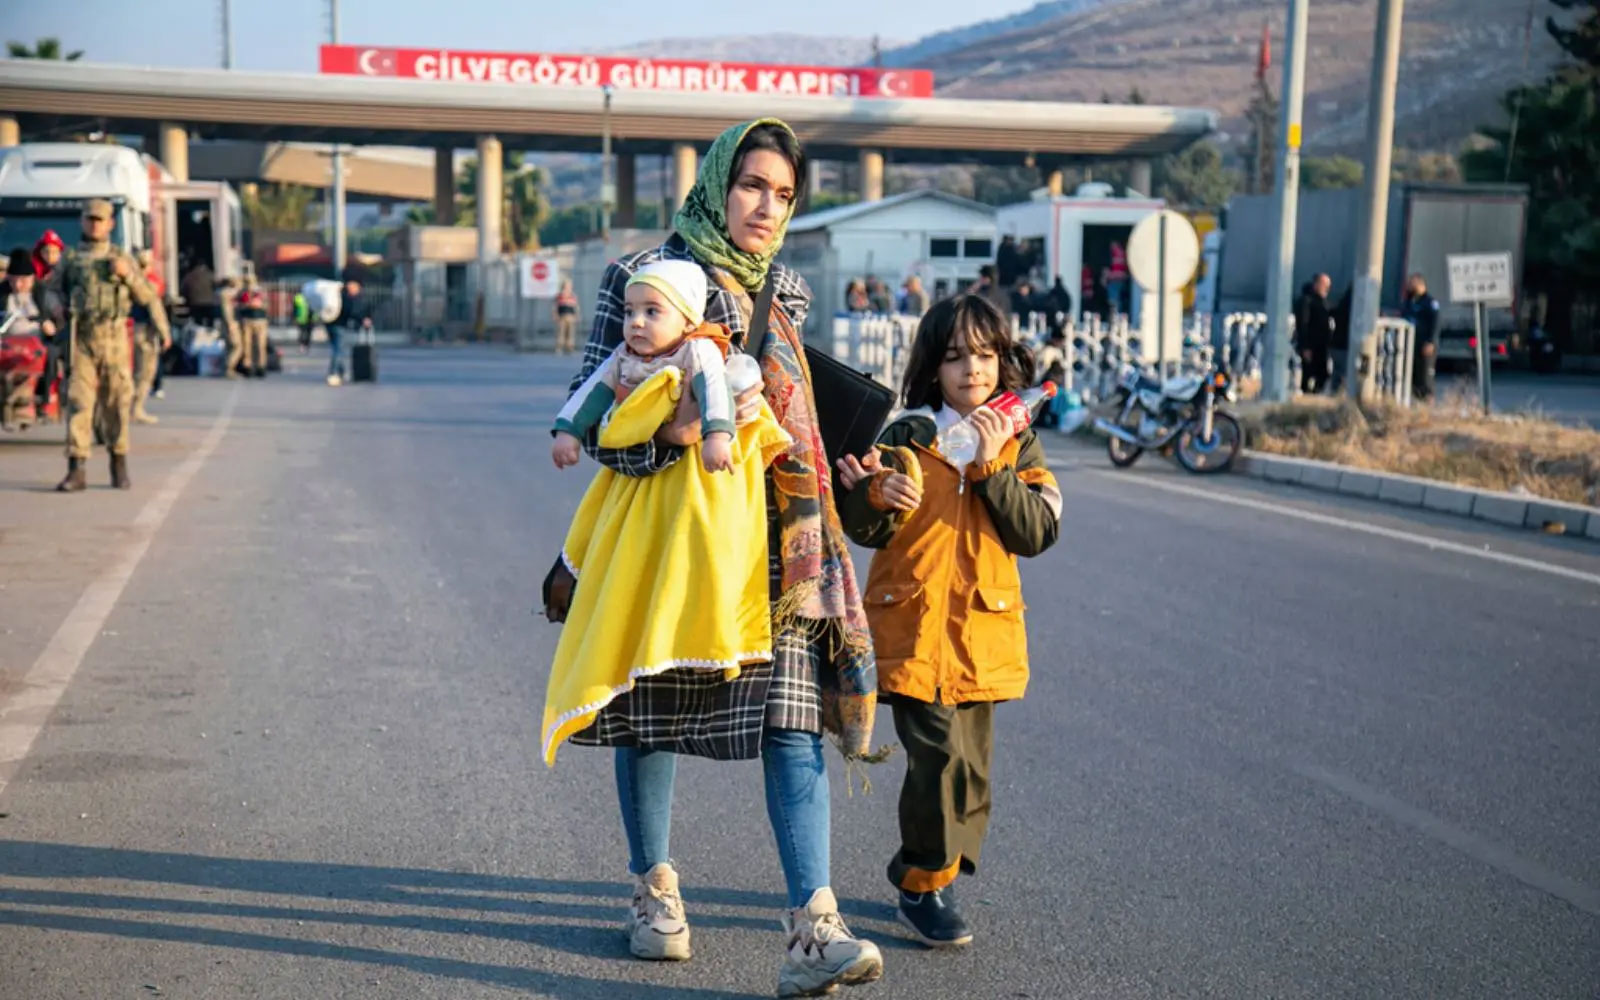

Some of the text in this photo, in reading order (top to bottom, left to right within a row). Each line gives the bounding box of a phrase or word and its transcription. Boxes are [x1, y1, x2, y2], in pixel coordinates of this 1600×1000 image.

[414, 51, 860, 96] CİLVEGÖZÜ GÜMRÜK KAPISI
